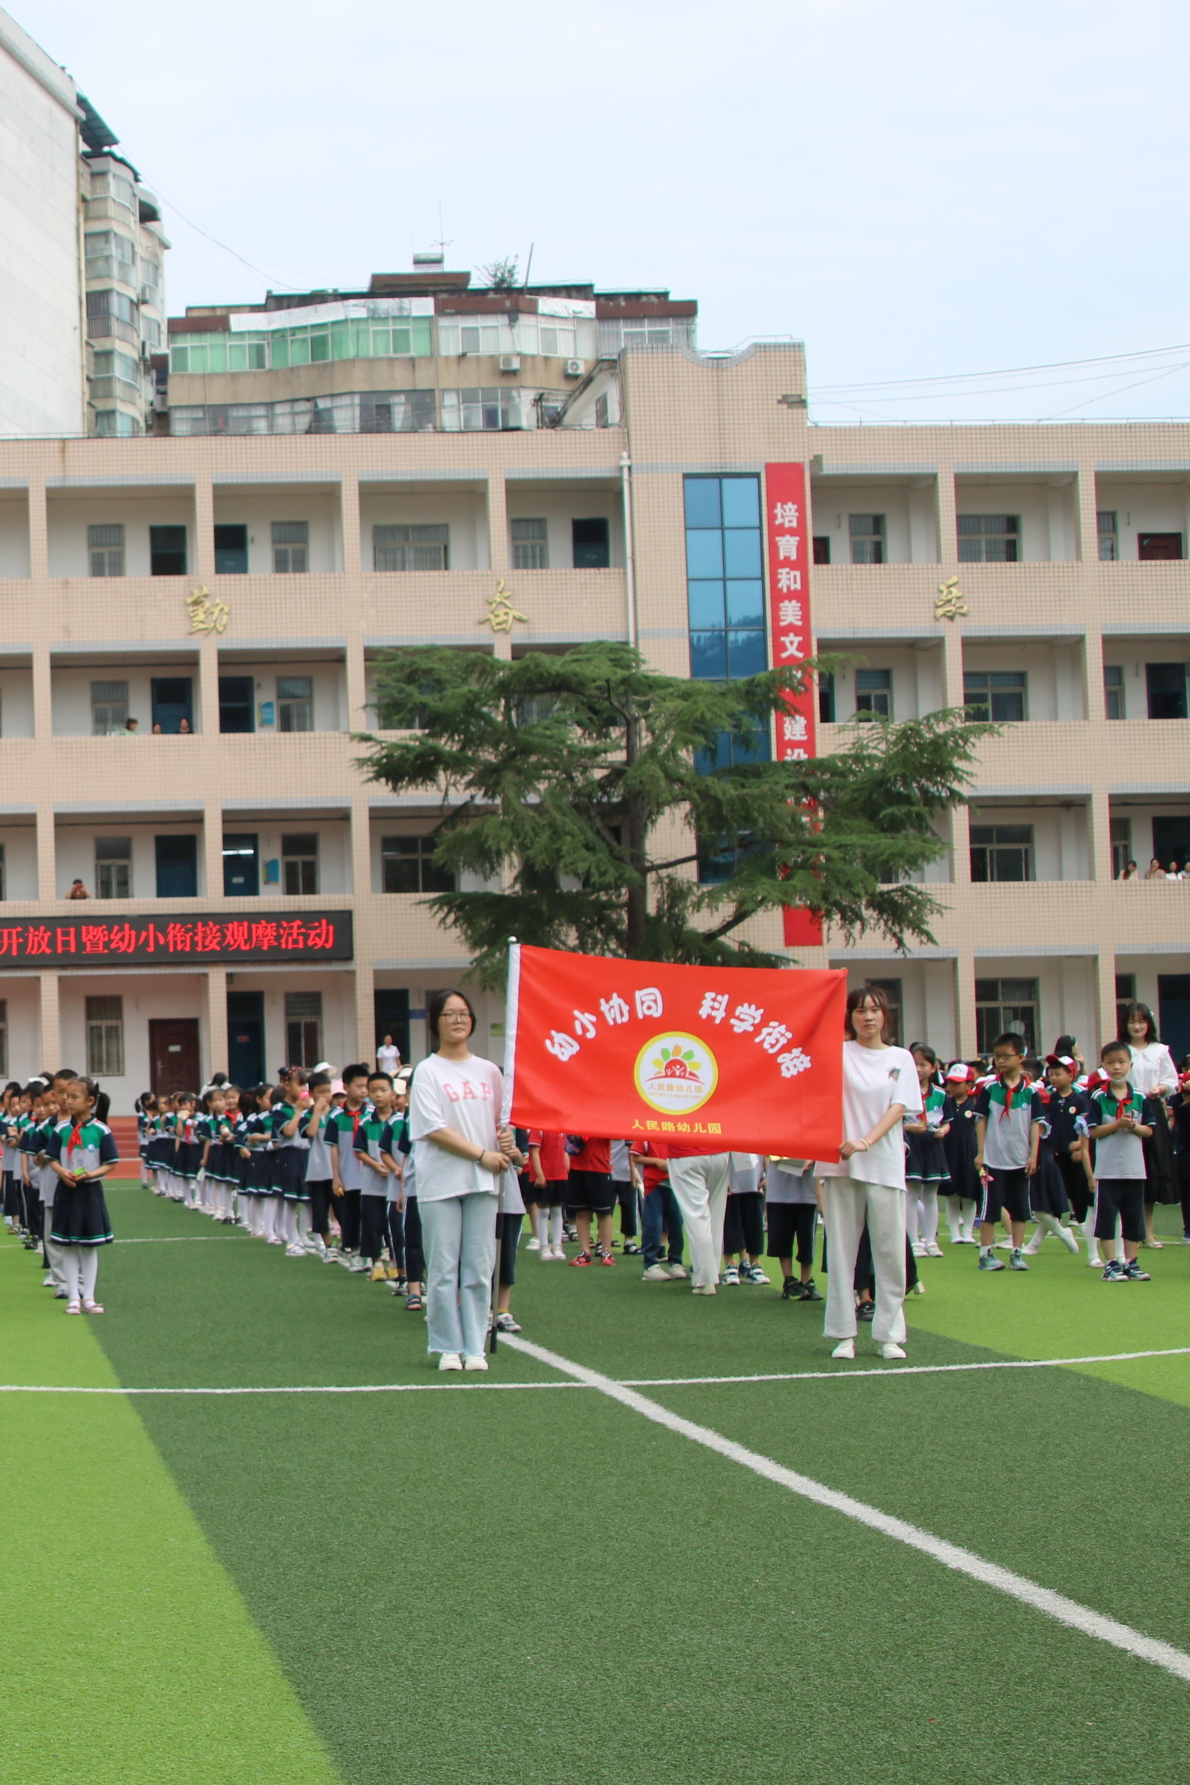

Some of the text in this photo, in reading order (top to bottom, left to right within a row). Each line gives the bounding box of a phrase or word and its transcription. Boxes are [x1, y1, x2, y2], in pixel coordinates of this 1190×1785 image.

[185, 585, 230, 636] 勤
[478, 579, 529, 634] 奋
[935, 575, 969, 622] 乐
[774, 502, 805, 691] 培育和美文
[545, 987, 812, 1078] 幼小协同 科学衔接
[631, 1119, 722, 1135] 人民路幼儿园
